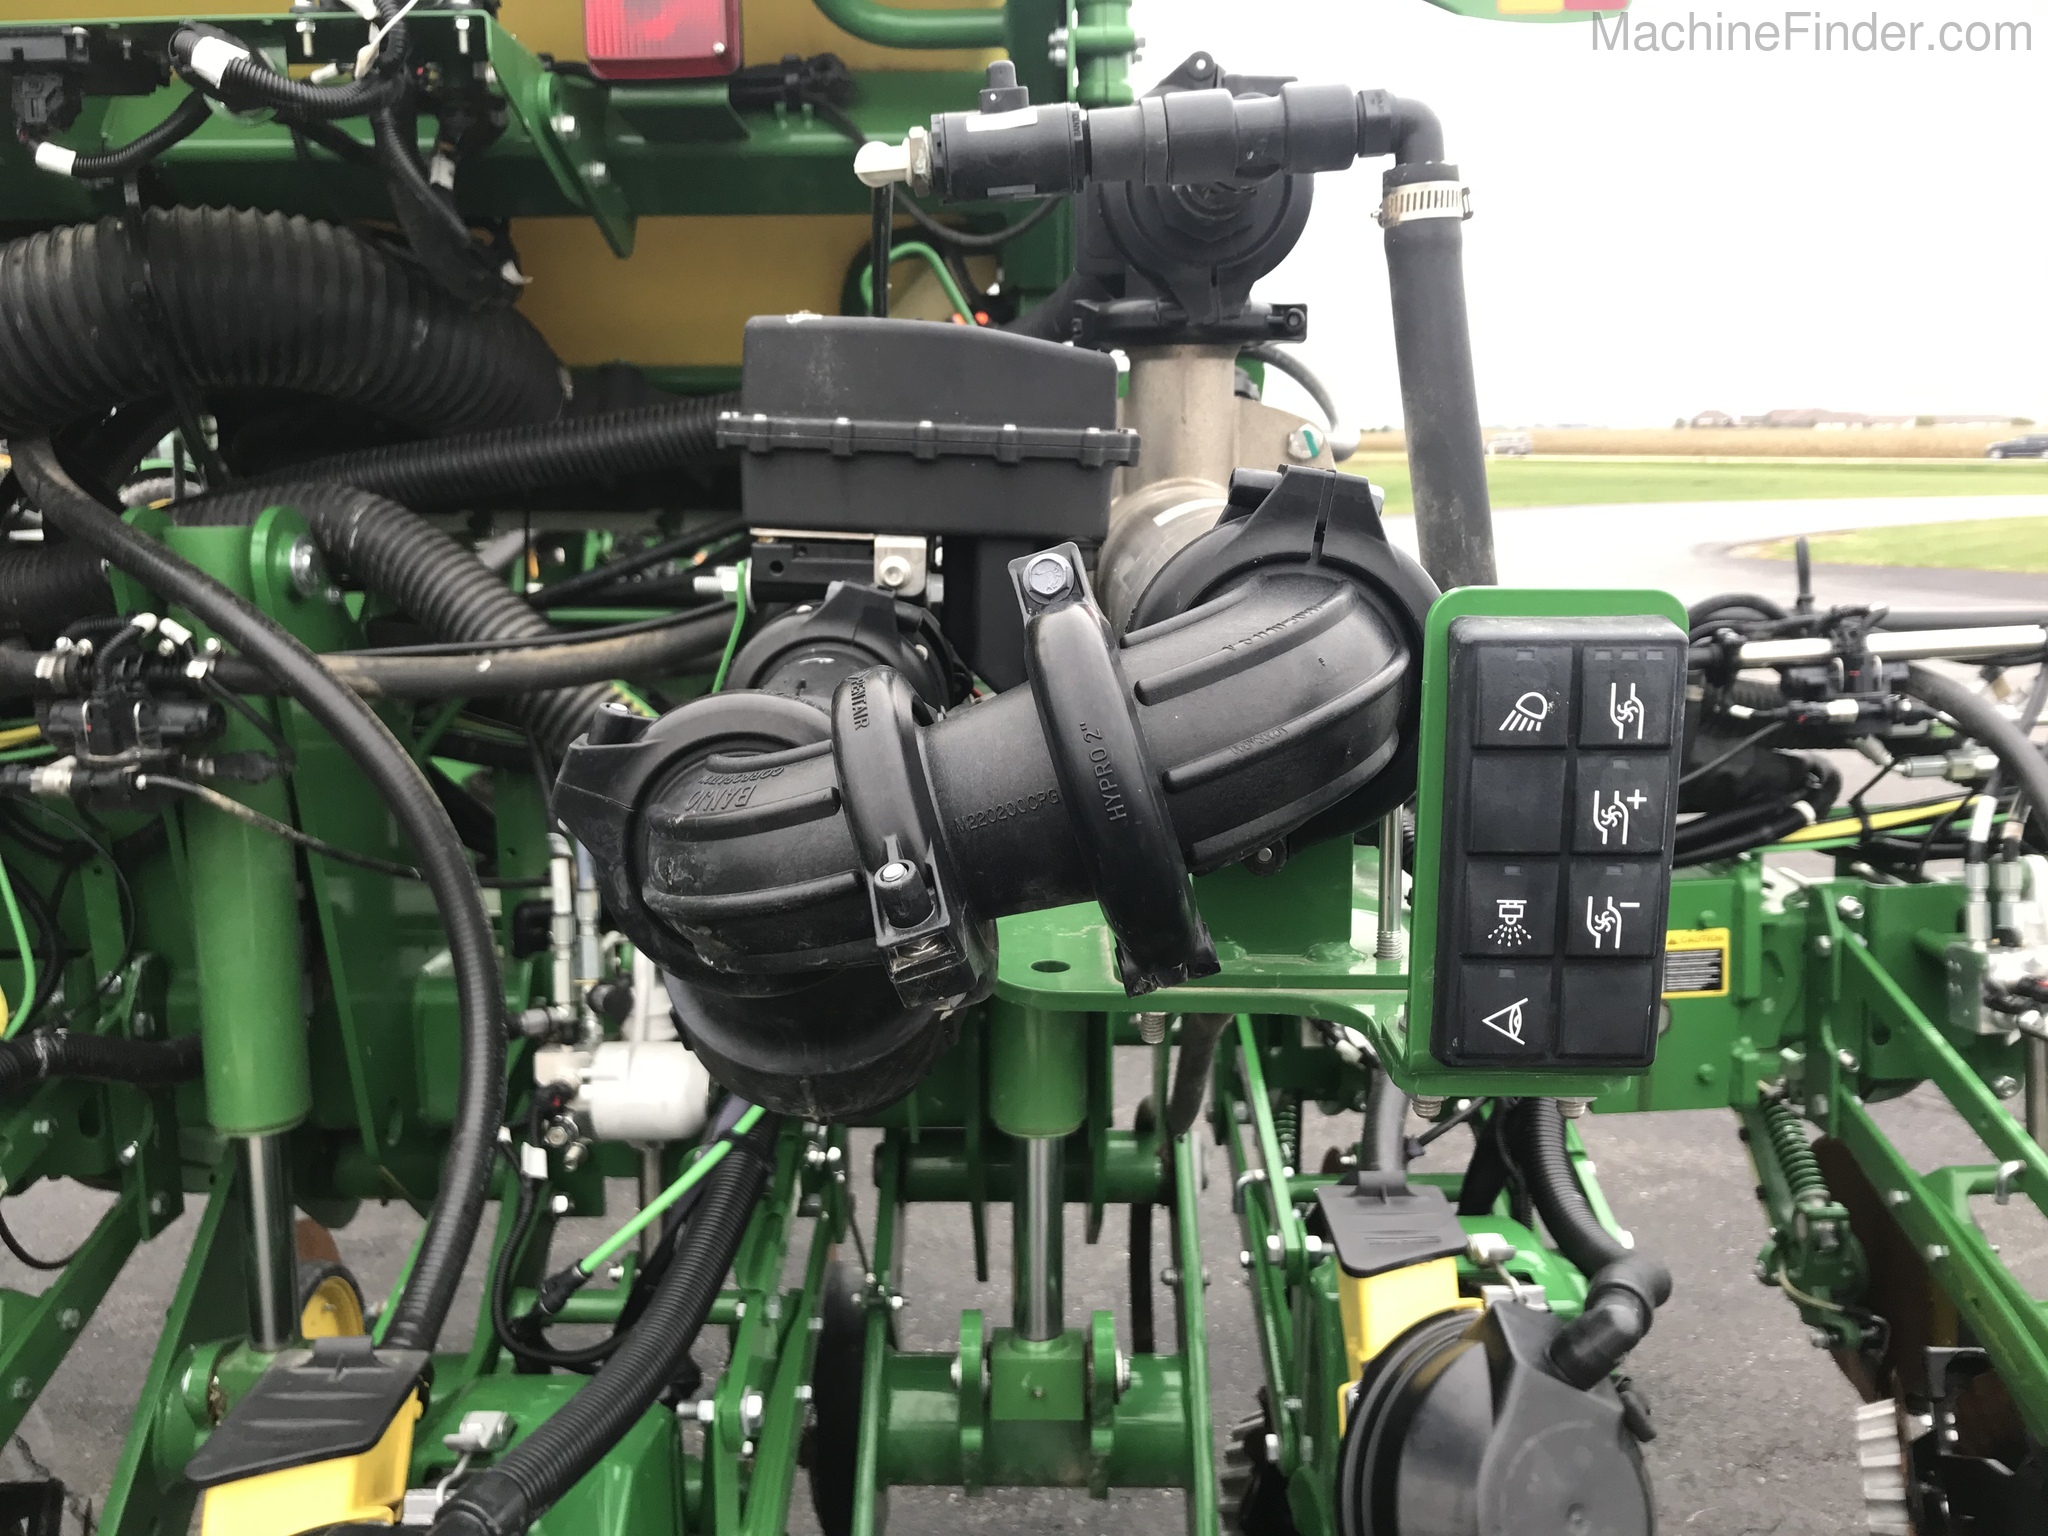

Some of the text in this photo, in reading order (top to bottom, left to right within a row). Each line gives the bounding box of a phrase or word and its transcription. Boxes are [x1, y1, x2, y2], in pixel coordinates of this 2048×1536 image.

[850, 678, 871, 731] PENTAIR
[685, 784, 758, 811] BANJO
[1079, 721, 1127, 821] HYPRO 2"
